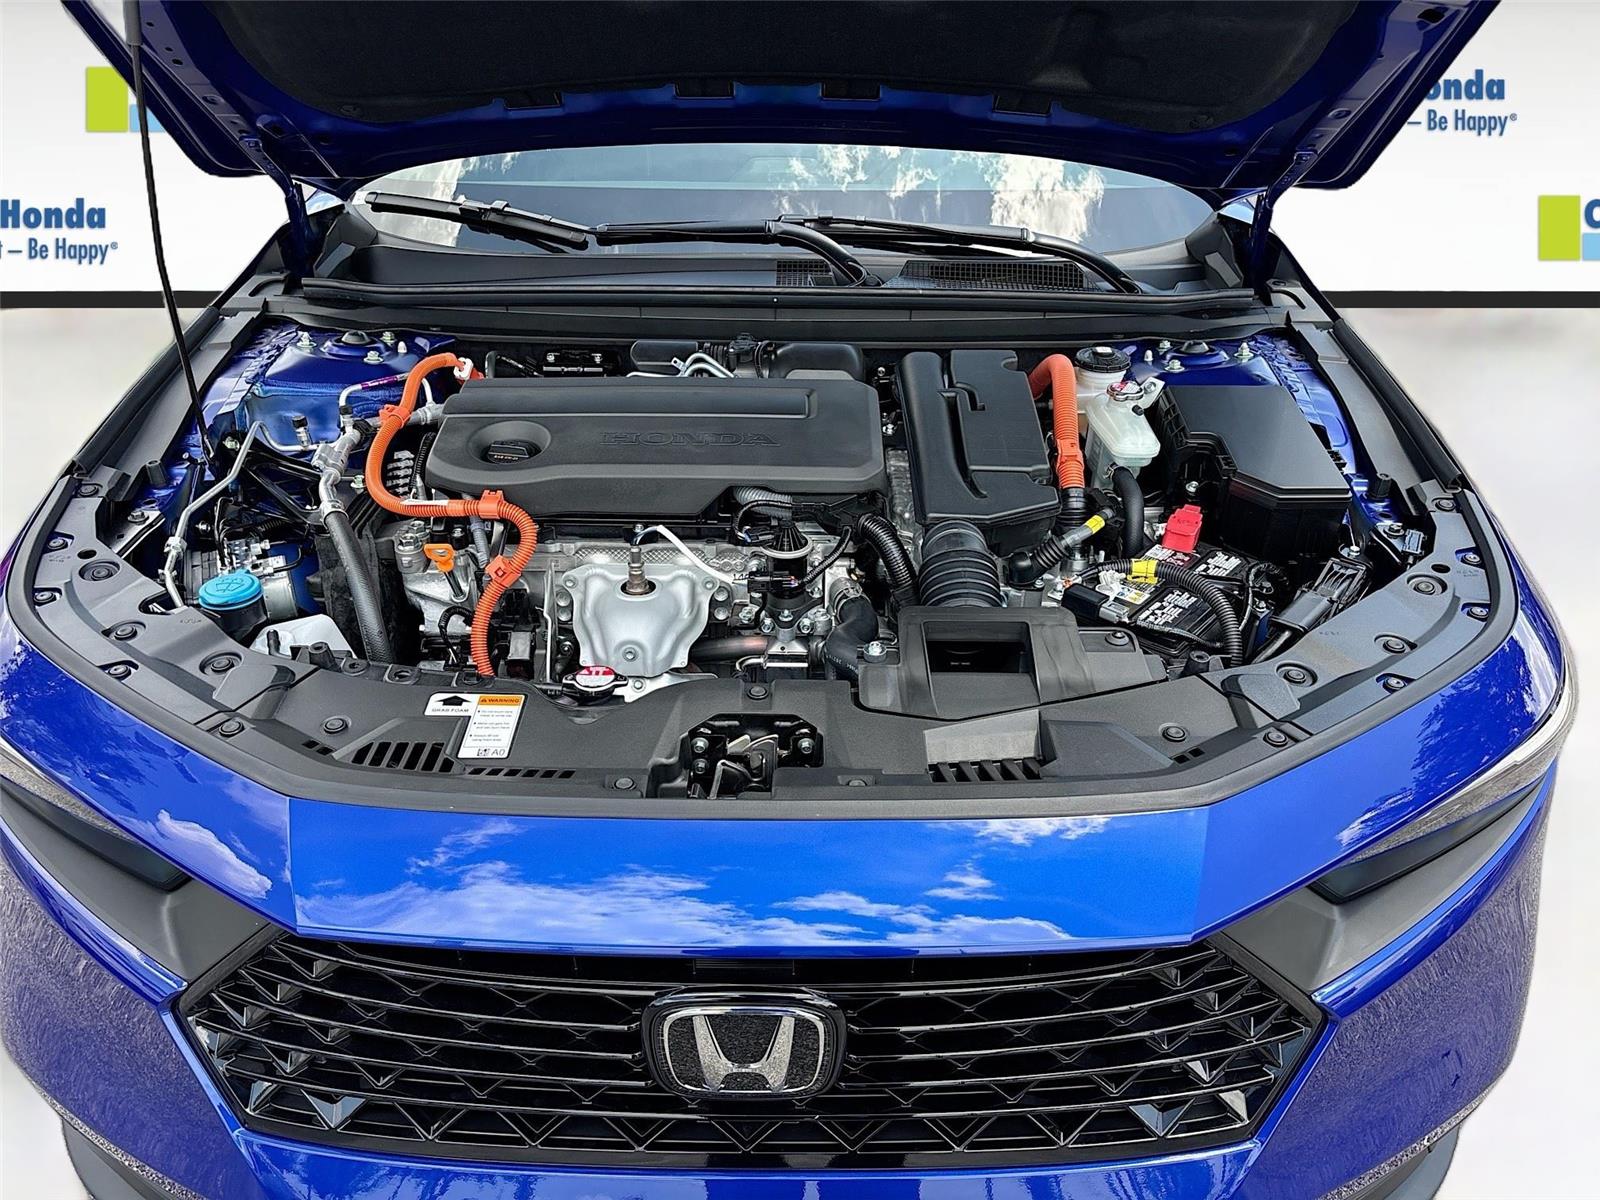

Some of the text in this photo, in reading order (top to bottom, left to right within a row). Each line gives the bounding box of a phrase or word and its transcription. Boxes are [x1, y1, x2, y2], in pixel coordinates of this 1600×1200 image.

[1425, 69, 1505, 100] onda
[1427, 109, 1448, 131] Be
[0, 197, 106, 229] Honda
[28, 237, 49, 260] Be
[600, 431, 781, 447] HONDA
